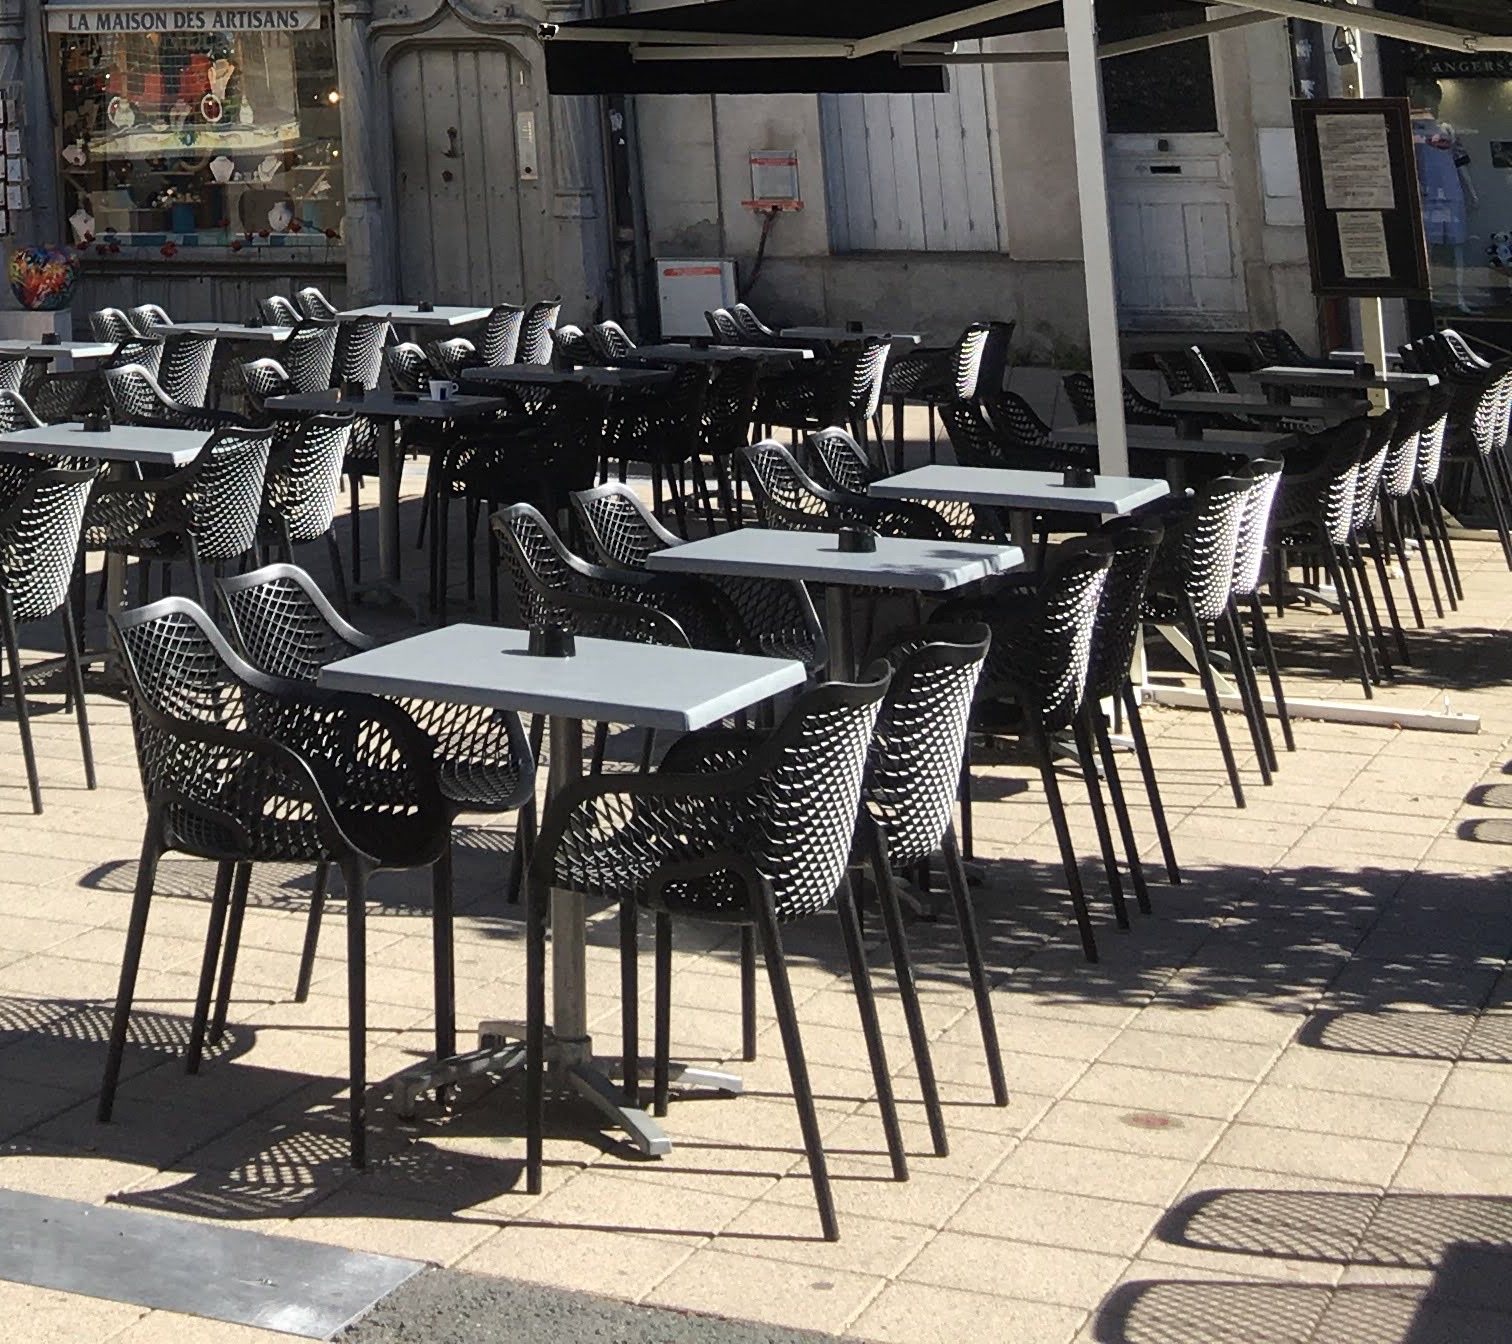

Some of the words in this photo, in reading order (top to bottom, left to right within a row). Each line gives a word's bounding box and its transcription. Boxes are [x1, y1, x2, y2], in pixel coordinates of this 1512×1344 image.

[68, 13, 89, 30] LA
[96, 12, 167, 30] MAISON
[174, 12, 206, 29] DES
[212, 11, 300, 29] ARTISANS
[1432, 61, 1504, 72] ANGERS
